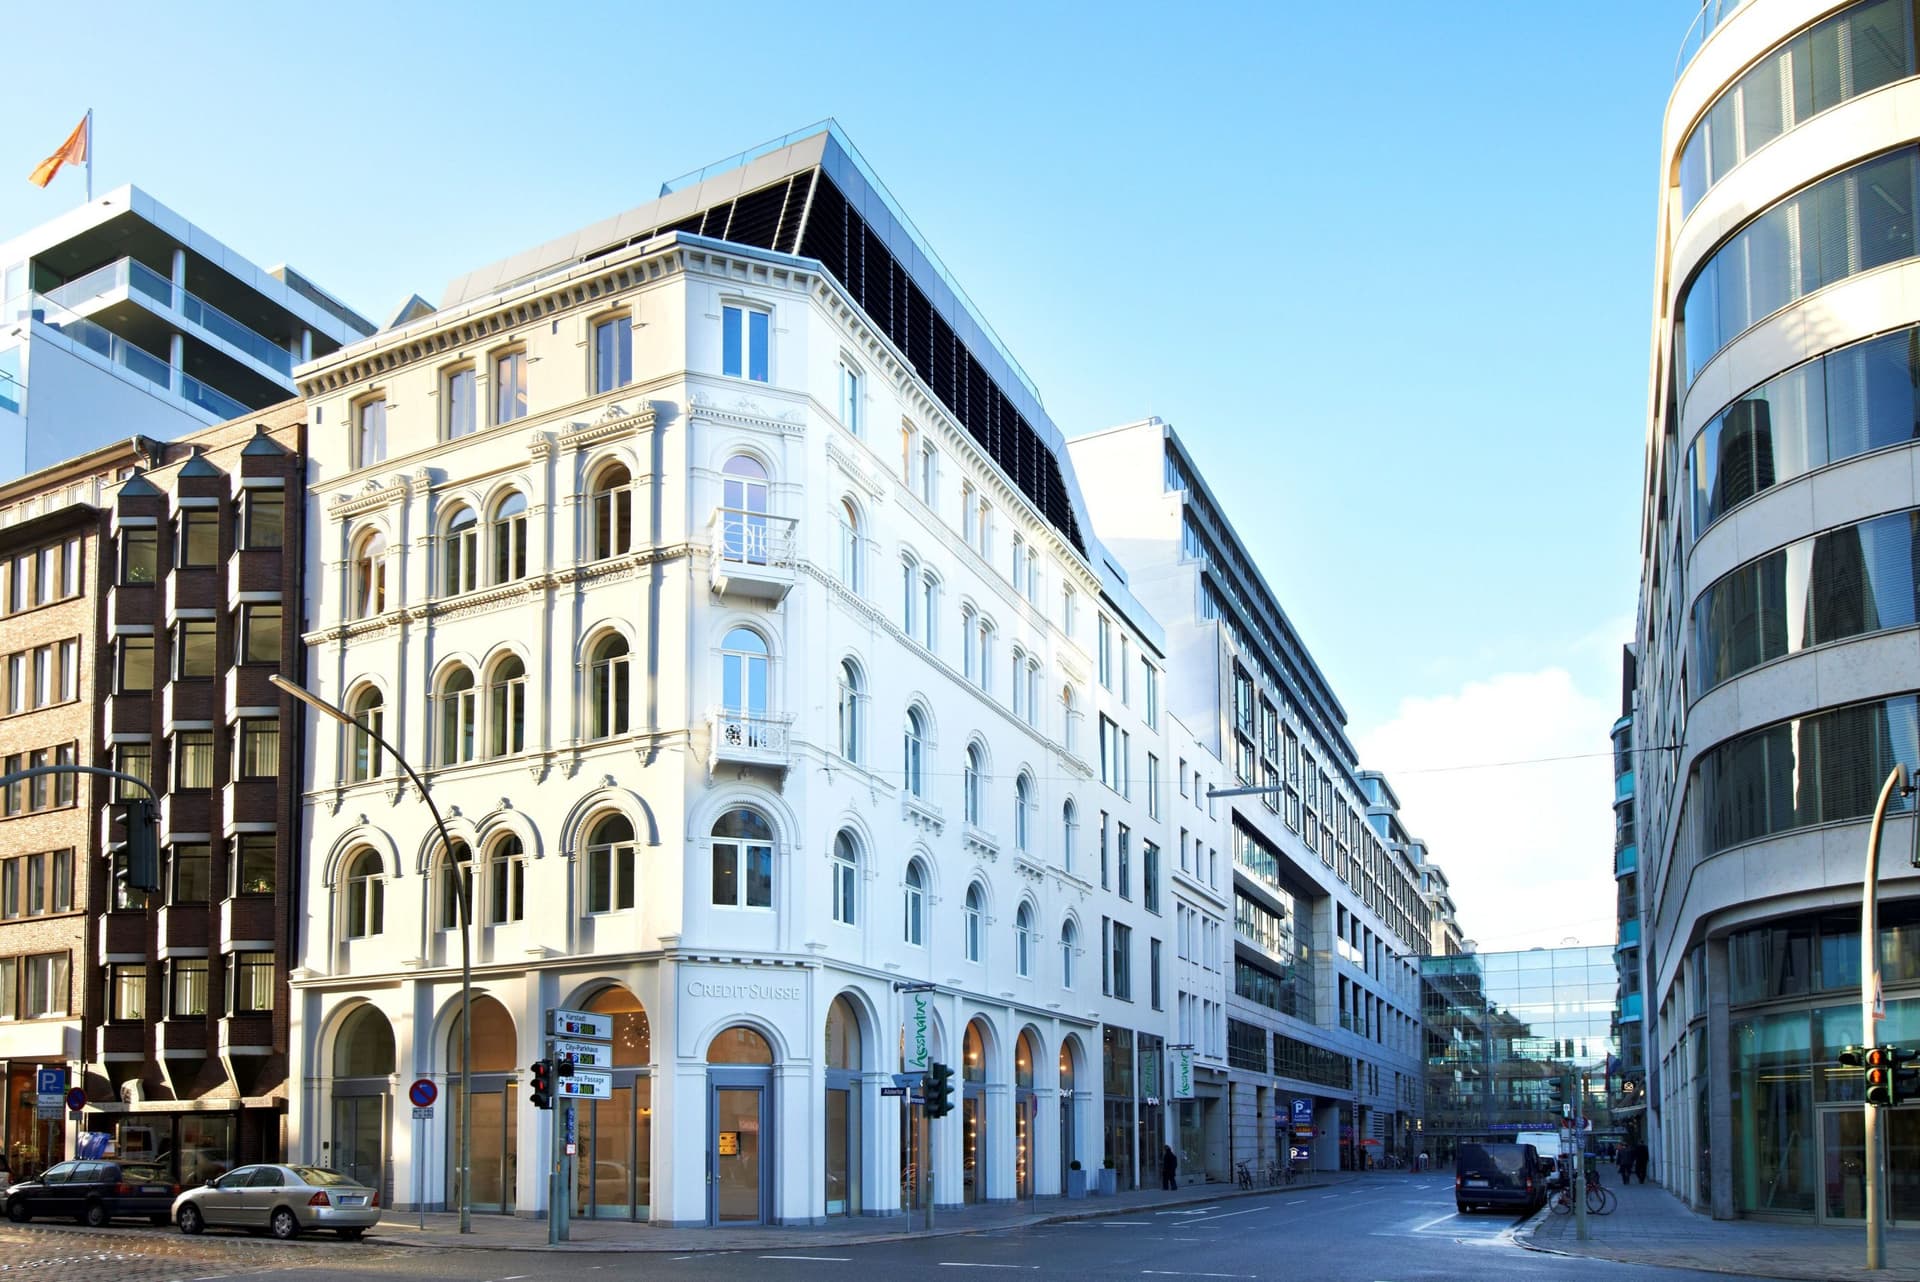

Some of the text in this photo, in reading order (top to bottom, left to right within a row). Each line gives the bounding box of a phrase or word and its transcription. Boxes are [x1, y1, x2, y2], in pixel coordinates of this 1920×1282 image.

[42, 1072, 56, 1091] P
[1295, 1103, 1304, 1114] P
[1290, 1150, 1298, 1160] P
